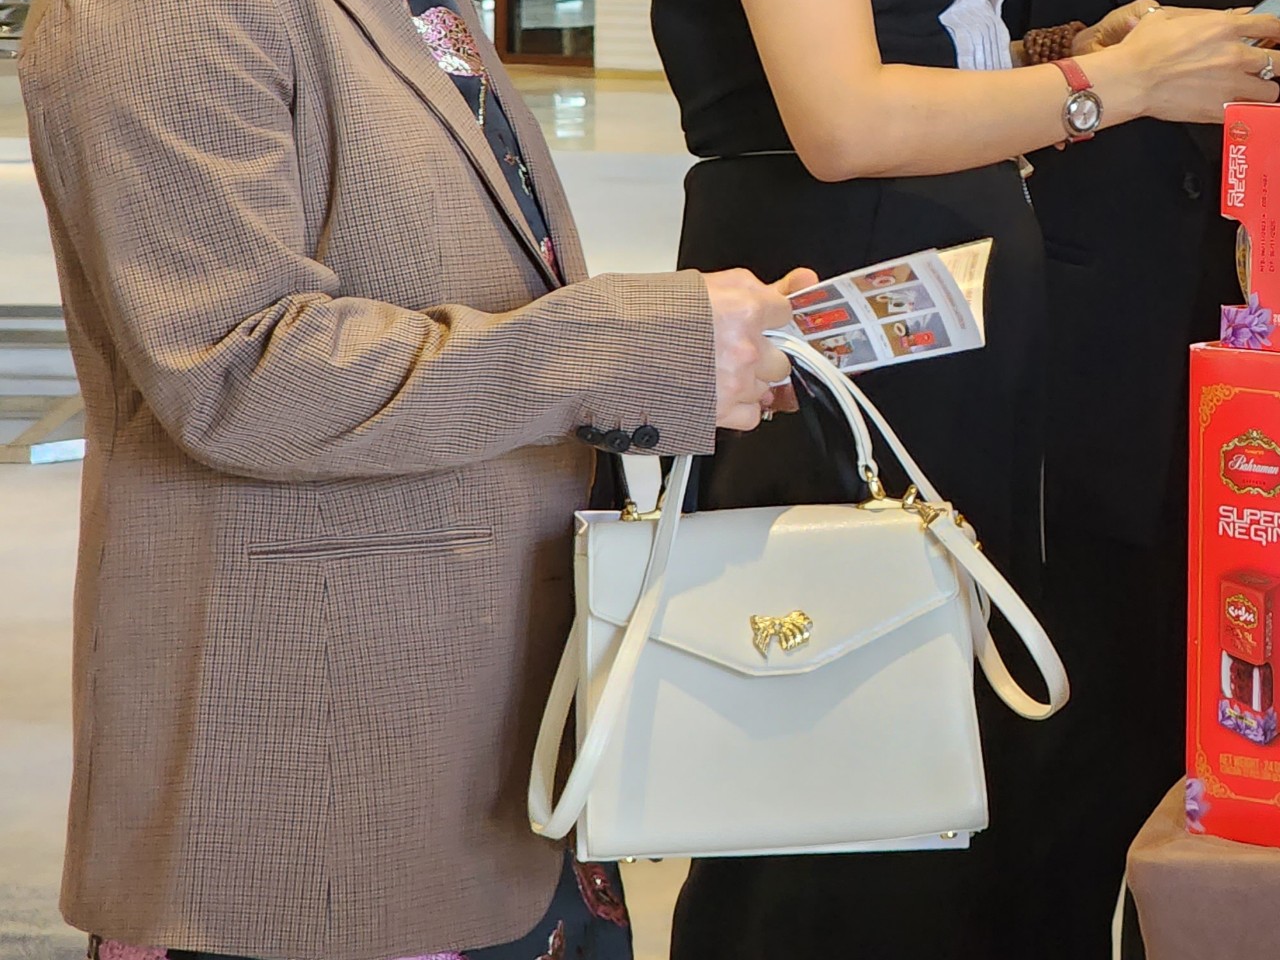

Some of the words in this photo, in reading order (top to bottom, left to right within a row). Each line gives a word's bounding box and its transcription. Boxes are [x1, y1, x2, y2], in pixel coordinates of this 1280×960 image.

[1227, 144, 1239, 207] SUPER
[1235, 145, 1248, 208] NEGIN
[1228, 453, 1279, 475] Bahraman
